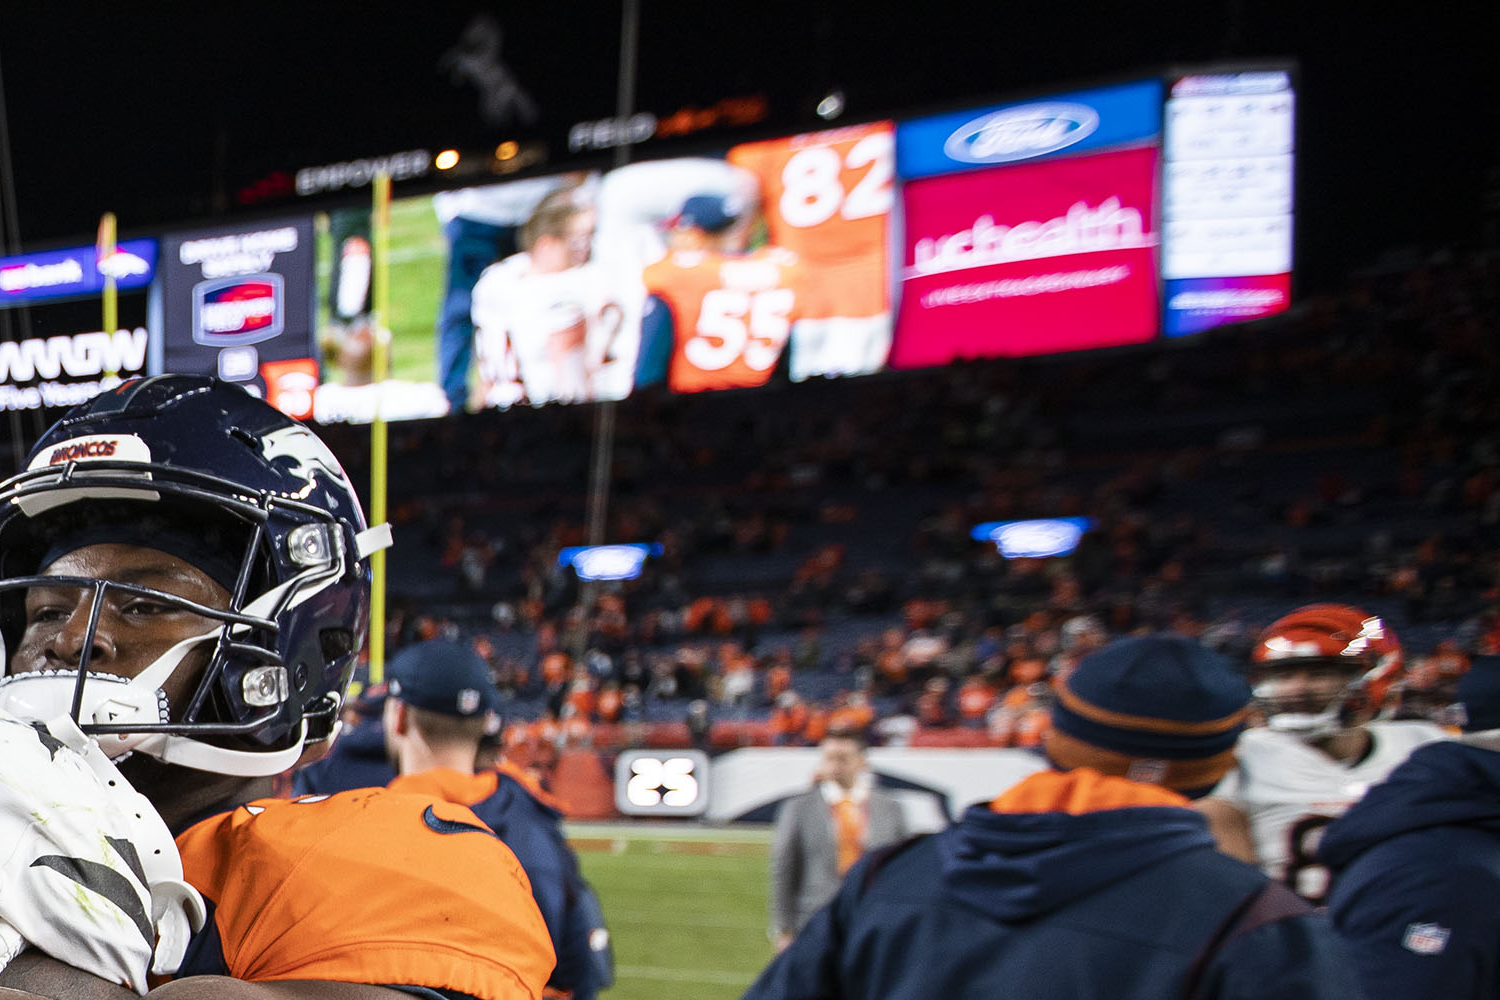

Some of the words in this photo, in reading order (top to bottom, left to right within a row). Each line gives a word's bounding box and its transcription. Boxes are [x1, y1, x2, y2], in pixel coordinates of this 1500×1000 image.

[295, 149, 431, 195] EMPOWER
[568, 112, 657, 154] FIELD
[780, 132, 893, 228] 82
[913, 196, 1144, 272] uchealth
[685, 288, 795, 371] 55
[49, 440, 119, 466] BRONCOS
